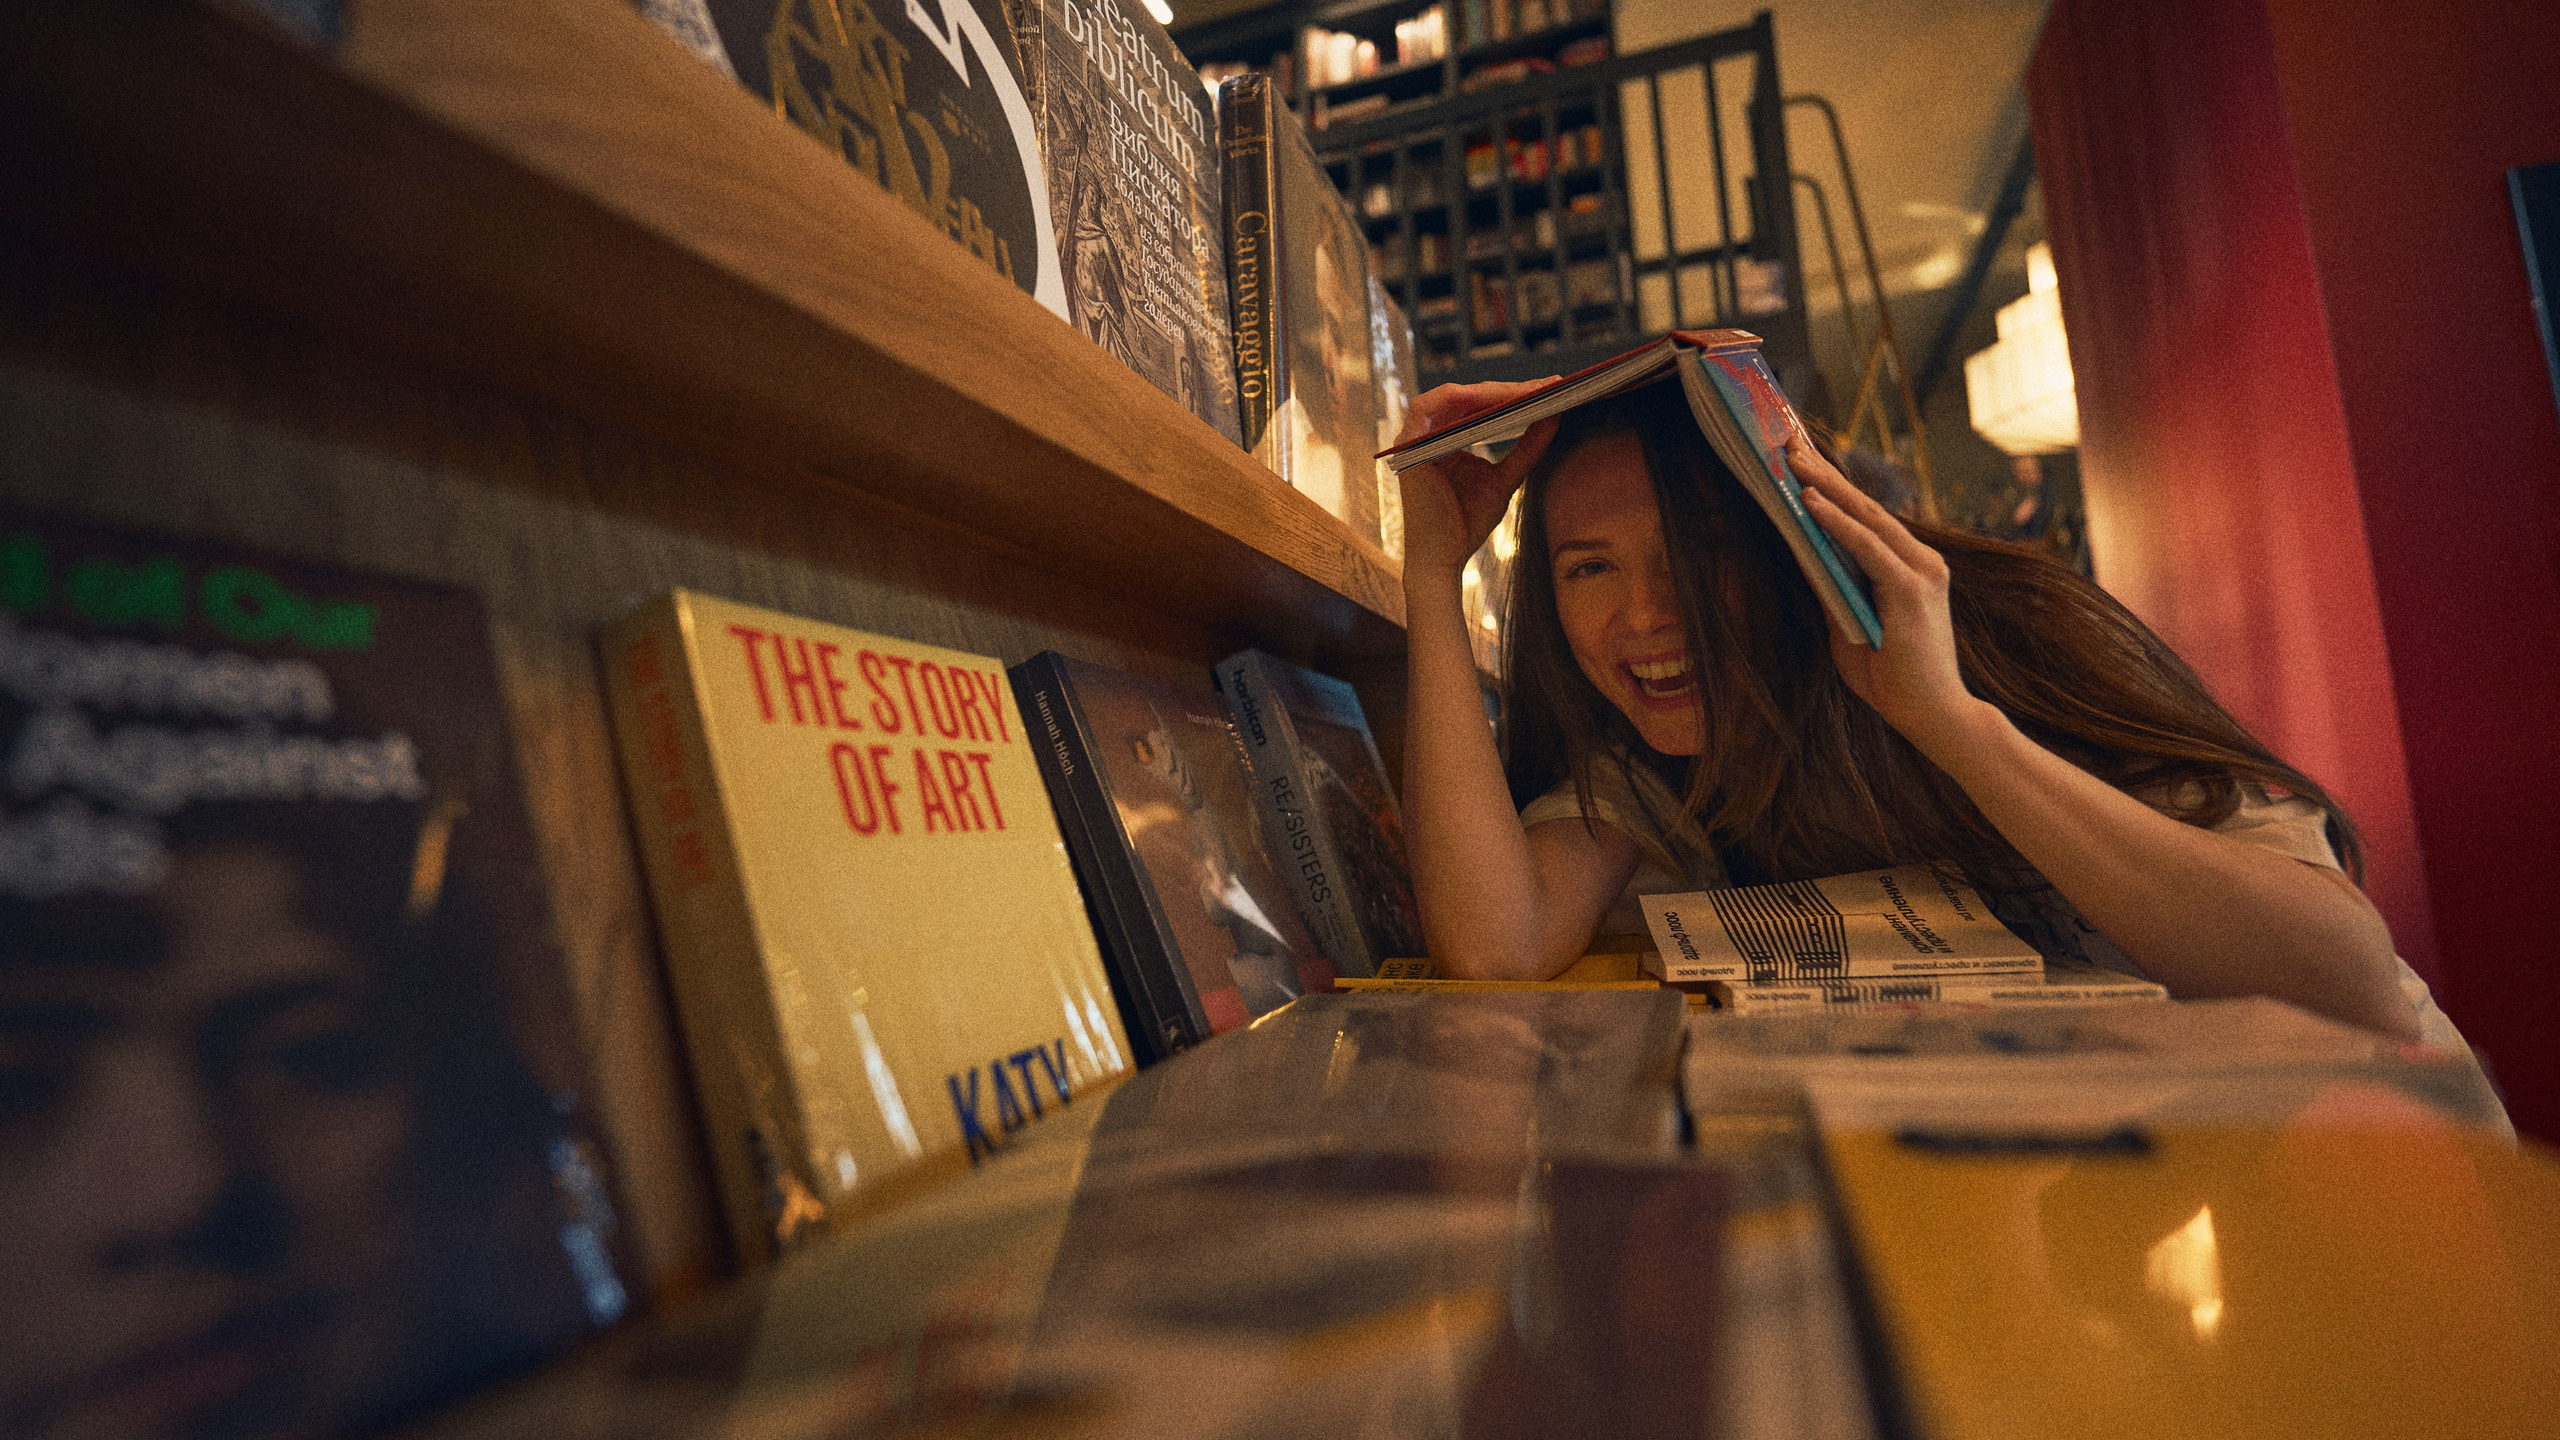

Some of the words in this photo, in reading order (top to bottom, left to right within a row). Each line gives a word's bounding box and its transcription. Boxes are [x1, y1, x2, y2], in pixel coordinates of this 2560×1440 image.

[1064, 0, 1198, 182] biblicum
[1109, 97, 1182, 203] Библия
[1111, 133, 1210, 262] Пискатора
[1113, 172, 1142, 215] 1643
[1144, 203, 1171, 241] года
[1139, 223, 1153, 246] из
[1153, 236, 1201, 292] собрания
[1143, 298, 1186, 343] галереи
[1233, 210, 1268, 399] Caravaggio
[726, 624, 862, 731] THE
[859, 648, 1012, 746] STORY
[1232, 668, 1267, 747] barbican
[1035, 690, 1062, 741] Hannah
[1054, 740, 1076, 777] Höch
[828, 741, 904, 837] OF
[915, 747, 1008, 835] ART
[1664, 911, 1685, 932] лоос
[1669, 932, 1702, 961] адольф
[1878, 875, 1948, 947] преступление
[1882, 913, 1934, 954] орнамент
[1956, 912, 1976, 922] ad
